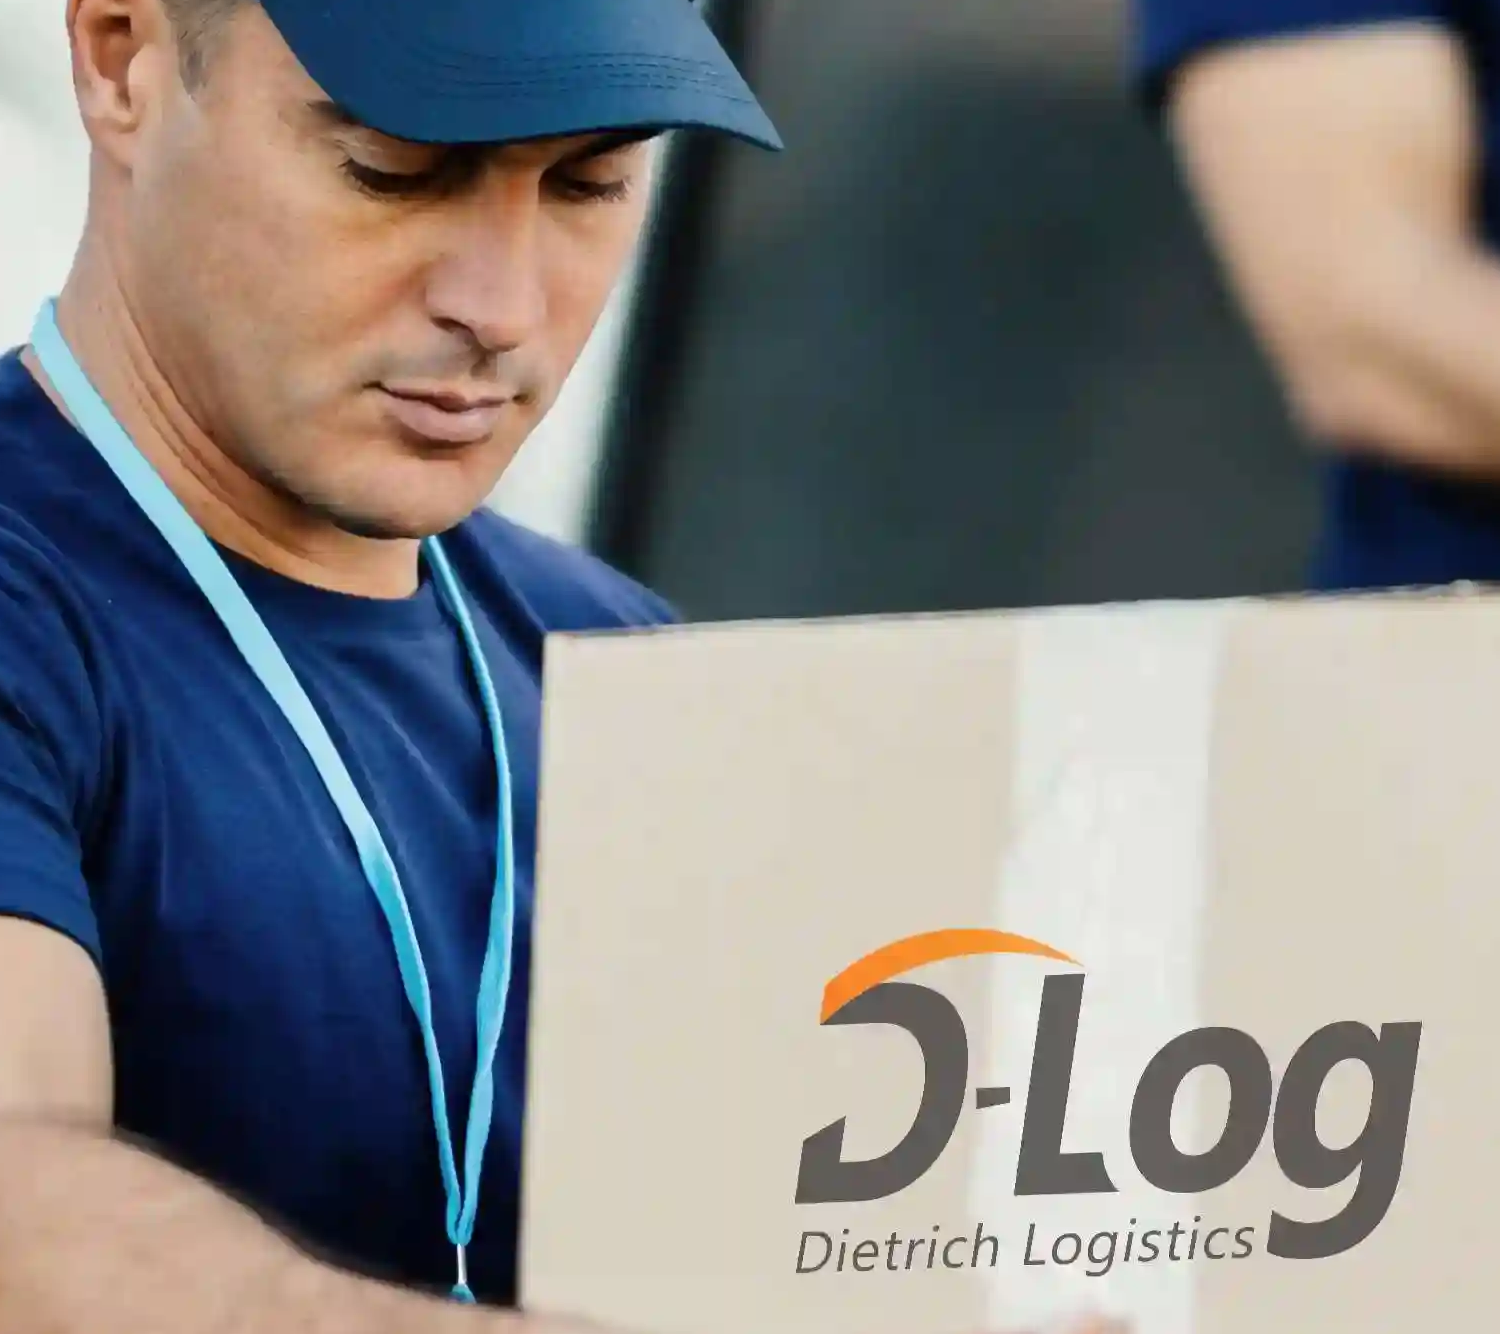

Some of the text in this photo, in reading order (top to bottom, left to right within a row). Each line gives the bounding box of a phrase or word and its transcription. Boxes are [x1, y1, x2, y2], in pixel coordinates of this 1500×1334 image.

[795, 929, 1423, 1260] D-Log
[796, 1216, 1255, 1277] Dietrich Logistics
